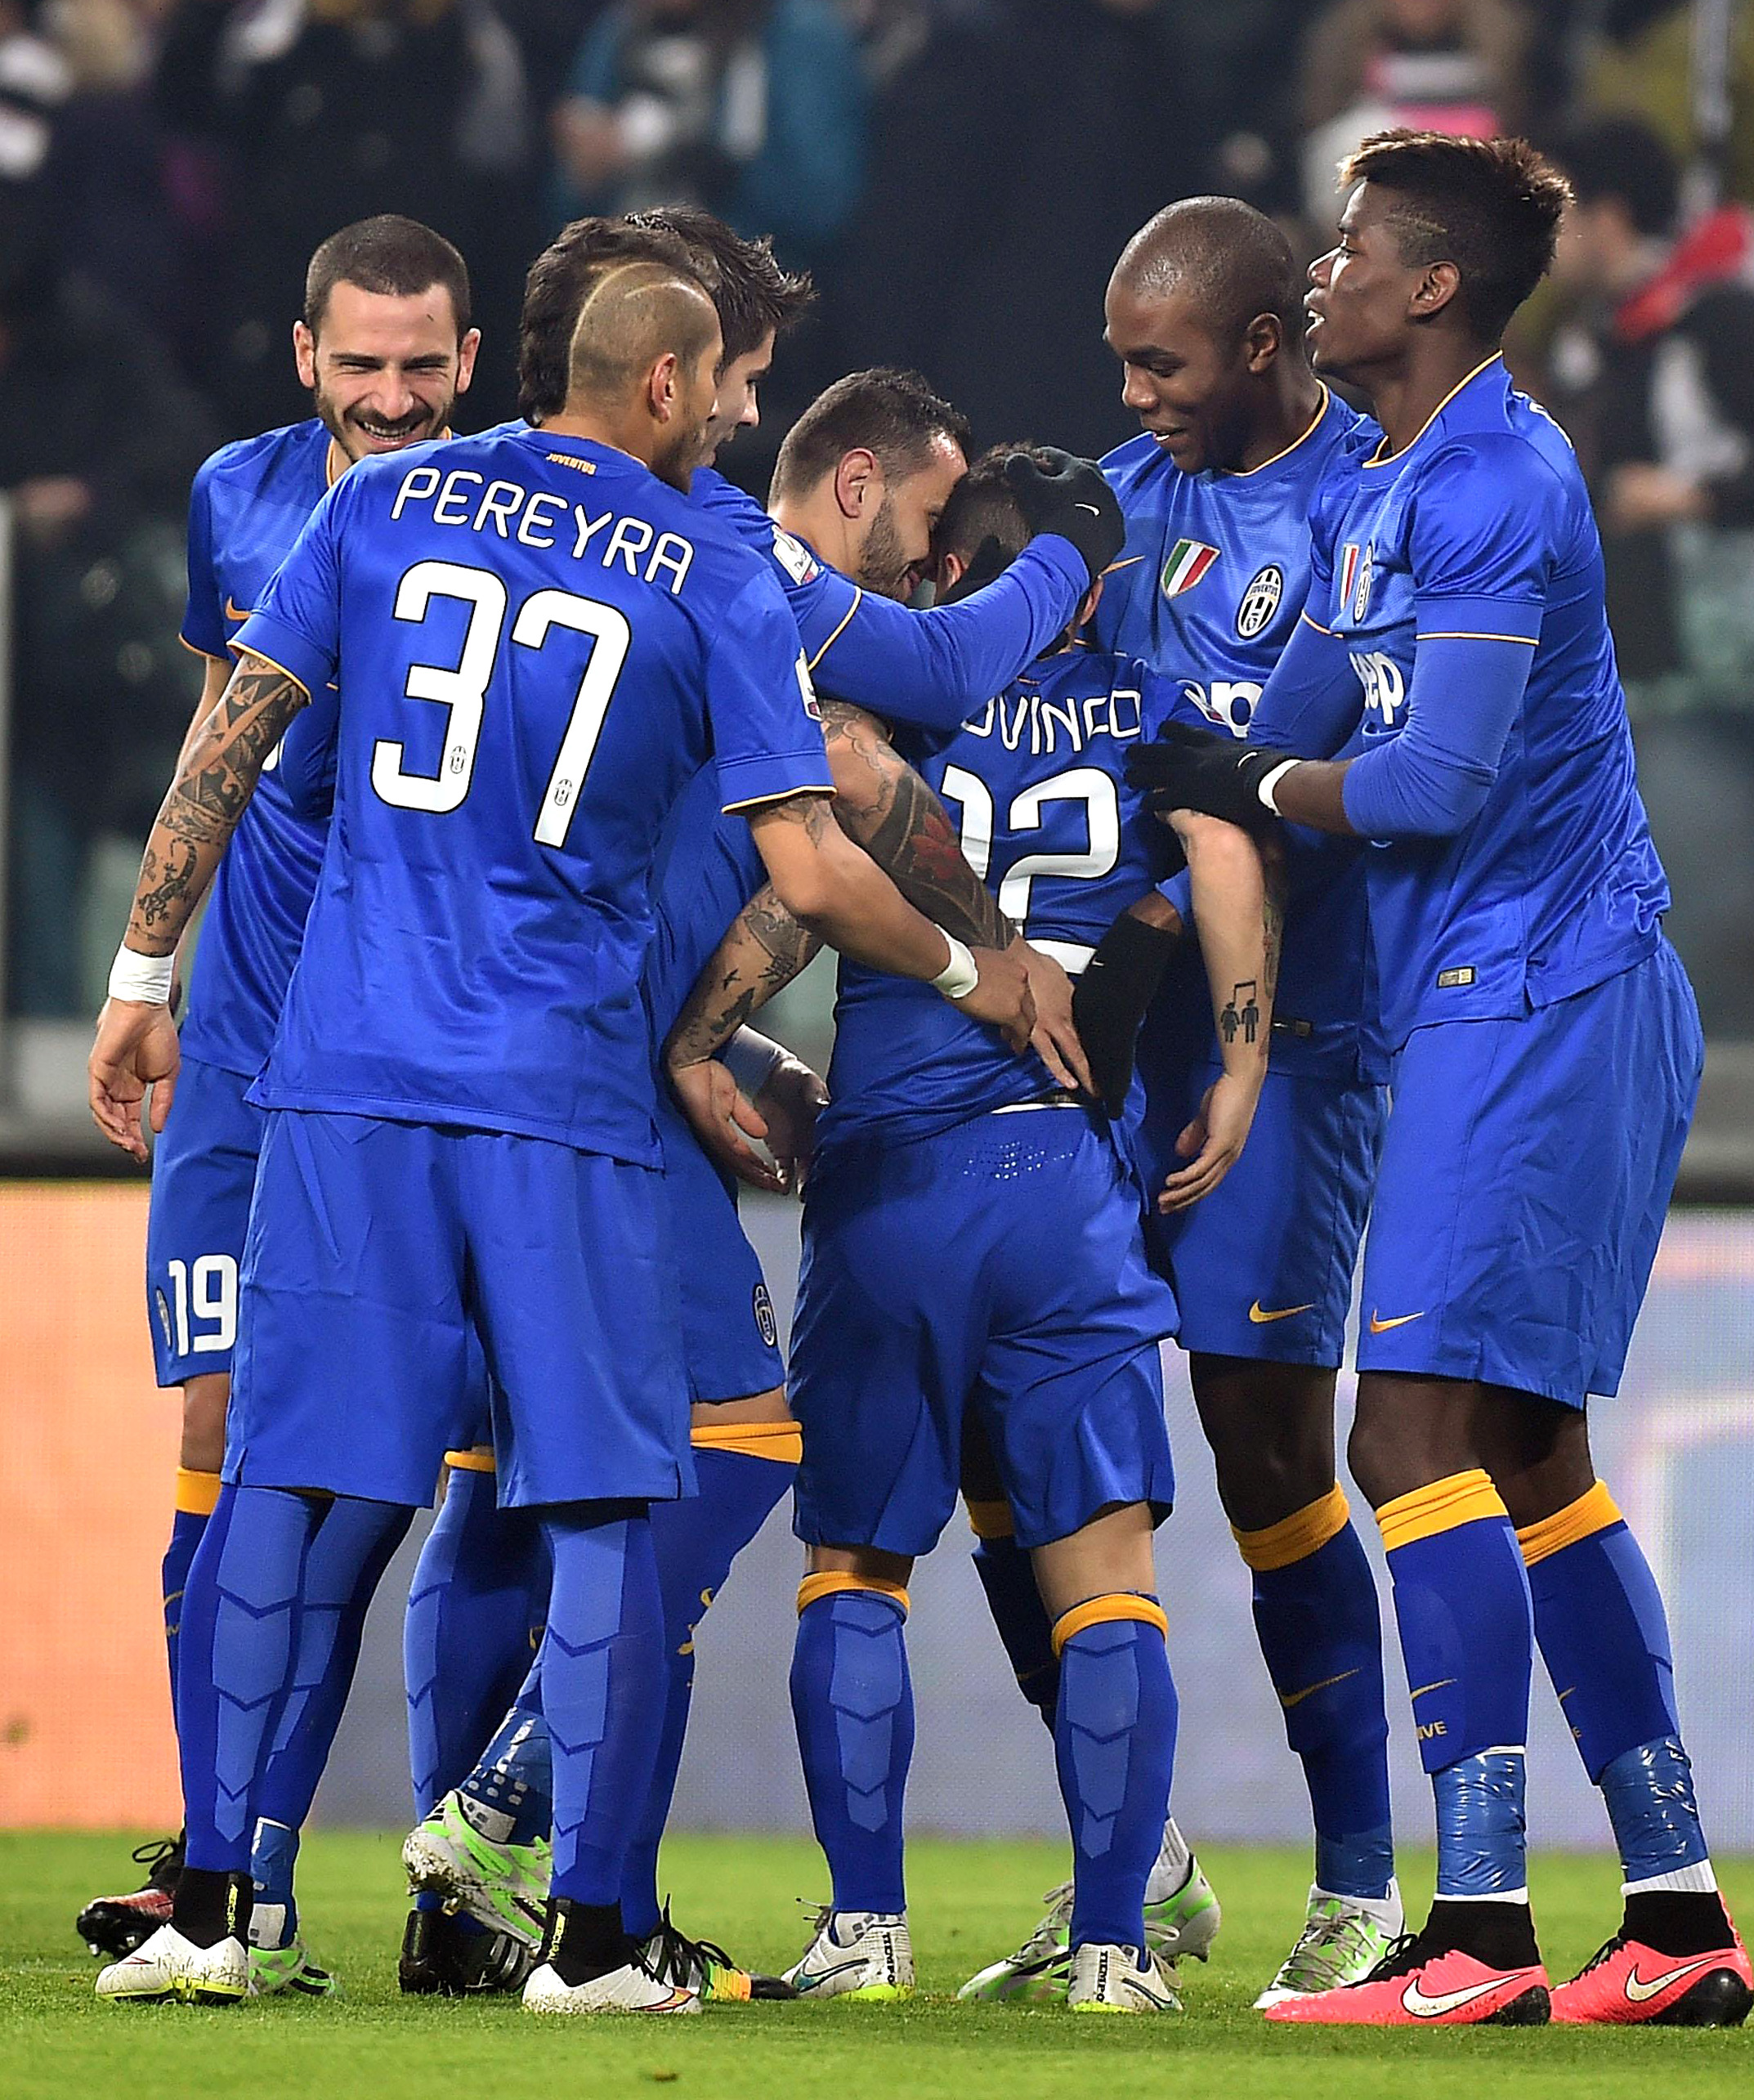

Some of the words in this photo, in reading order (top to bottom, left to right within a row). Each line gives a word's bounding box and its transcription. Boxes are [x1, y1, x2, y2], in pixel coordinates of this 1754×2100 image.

[391, 467, 694, 595] PEREYRA
[370, 560, 632, 848] 37
[941, 766, 1120, 974] 12
[168, 1254, 238, 1357] 19
